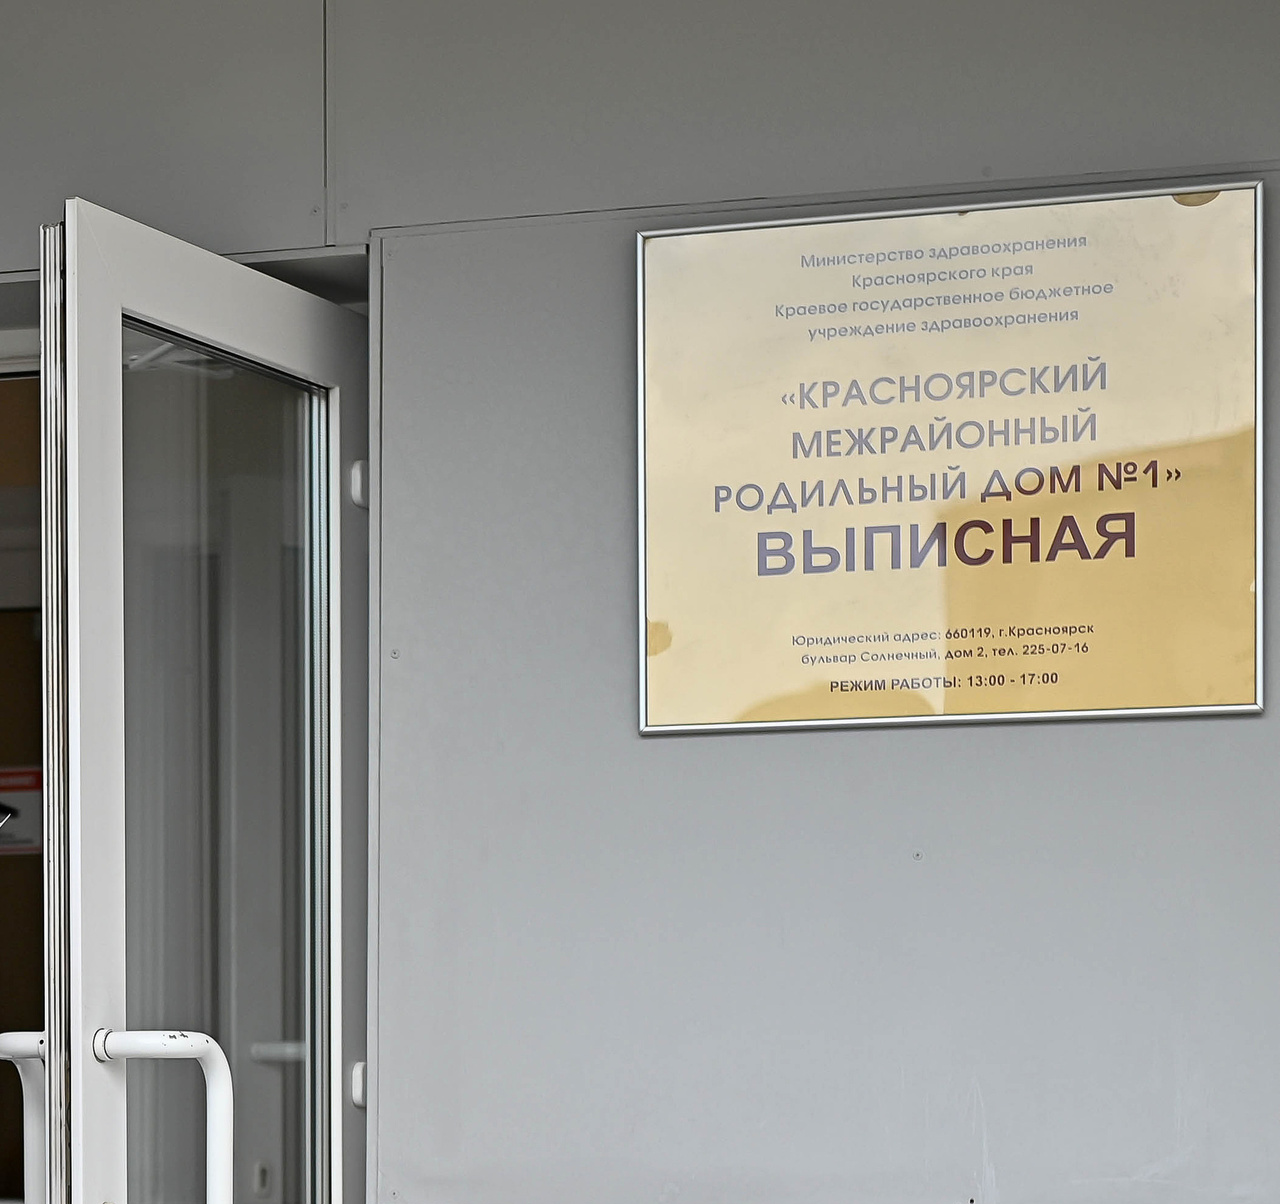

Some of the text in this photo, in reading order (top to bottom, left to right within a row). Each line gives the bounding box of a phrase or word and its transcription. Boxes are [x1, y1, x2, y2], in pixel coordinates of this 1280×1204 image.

[800, 236, 1087, 268] Министерство здравоохранения
[851, 264, 1034, 290] Красноярского края
[775, 283, 1114, 319] Краевое государственное бюджетное
[807, 309, 1079, 343] учреждение здравоохранения
[781, 356, 1108, 410] «КРАСНОЯРСКИЙ
[791, 407, 1097, 460] МЕЖРАЙОННЫЙ
[714, 464, 967, 515] РОДИЛЬНЫЙ
[980, 463, 1081, 503] ДОМ
[756, 511, 1137, 577] ВЫПИСНАЯ
[791, 623, 1095, 649] Юридический адрес: 660119, г.Красноярск
[800, 642, 1090, 666] бульвар Солнечный, дом 2, тел. 225-07-16
[829, 678, 887, 693] РЕЖИМ
[890, 675, 963, 691] РАБОТЫ:
[966, 673, 1006, 688] 13:00
[1019, 671, 1059, 686] 17:00
